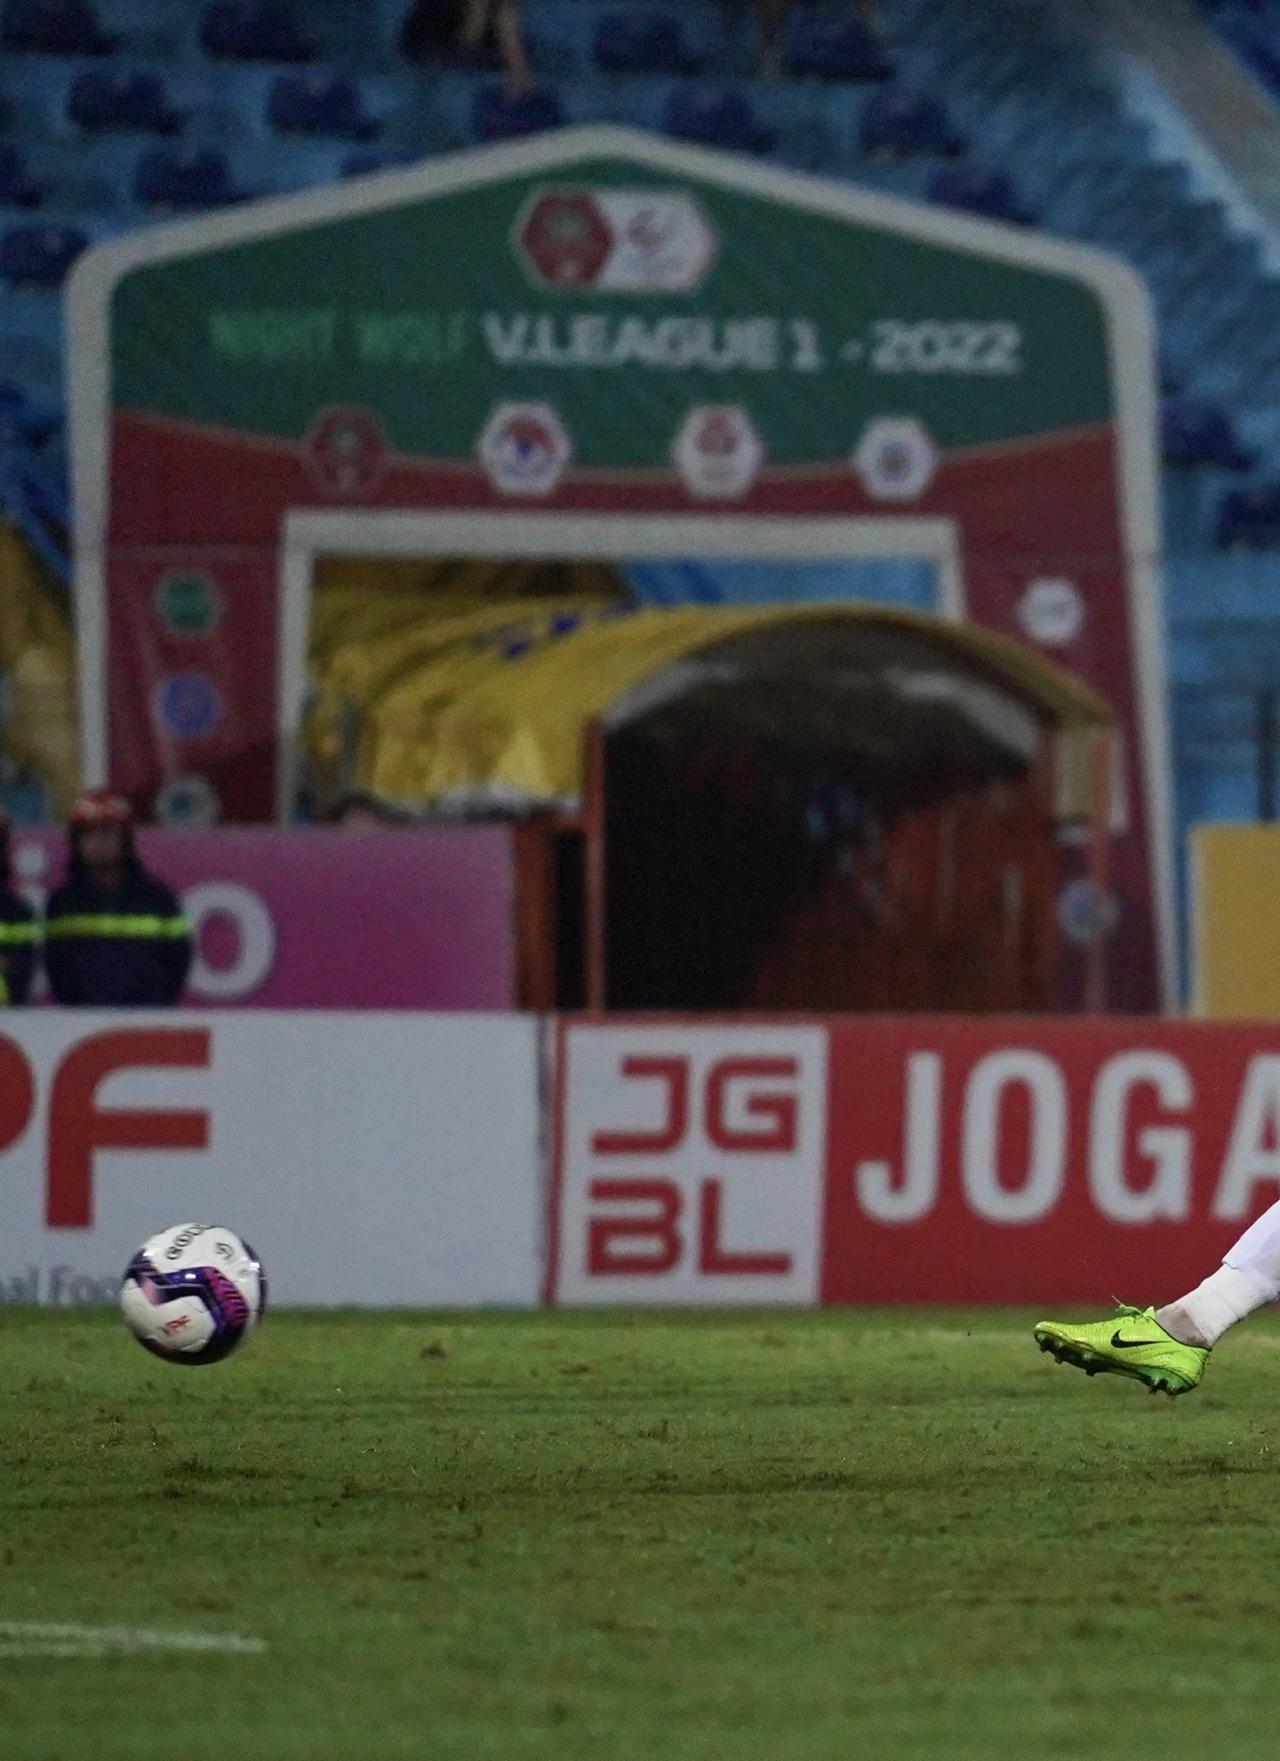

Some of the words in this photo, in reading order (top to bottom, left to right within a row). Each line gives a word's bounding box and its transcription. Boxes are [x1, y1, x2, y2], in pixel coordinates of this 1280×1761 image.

[482, 312, 780, 373] V.LEAGUE
[790, 317, 823, 374] 1
[868, 320, 1024, 378] 2022
